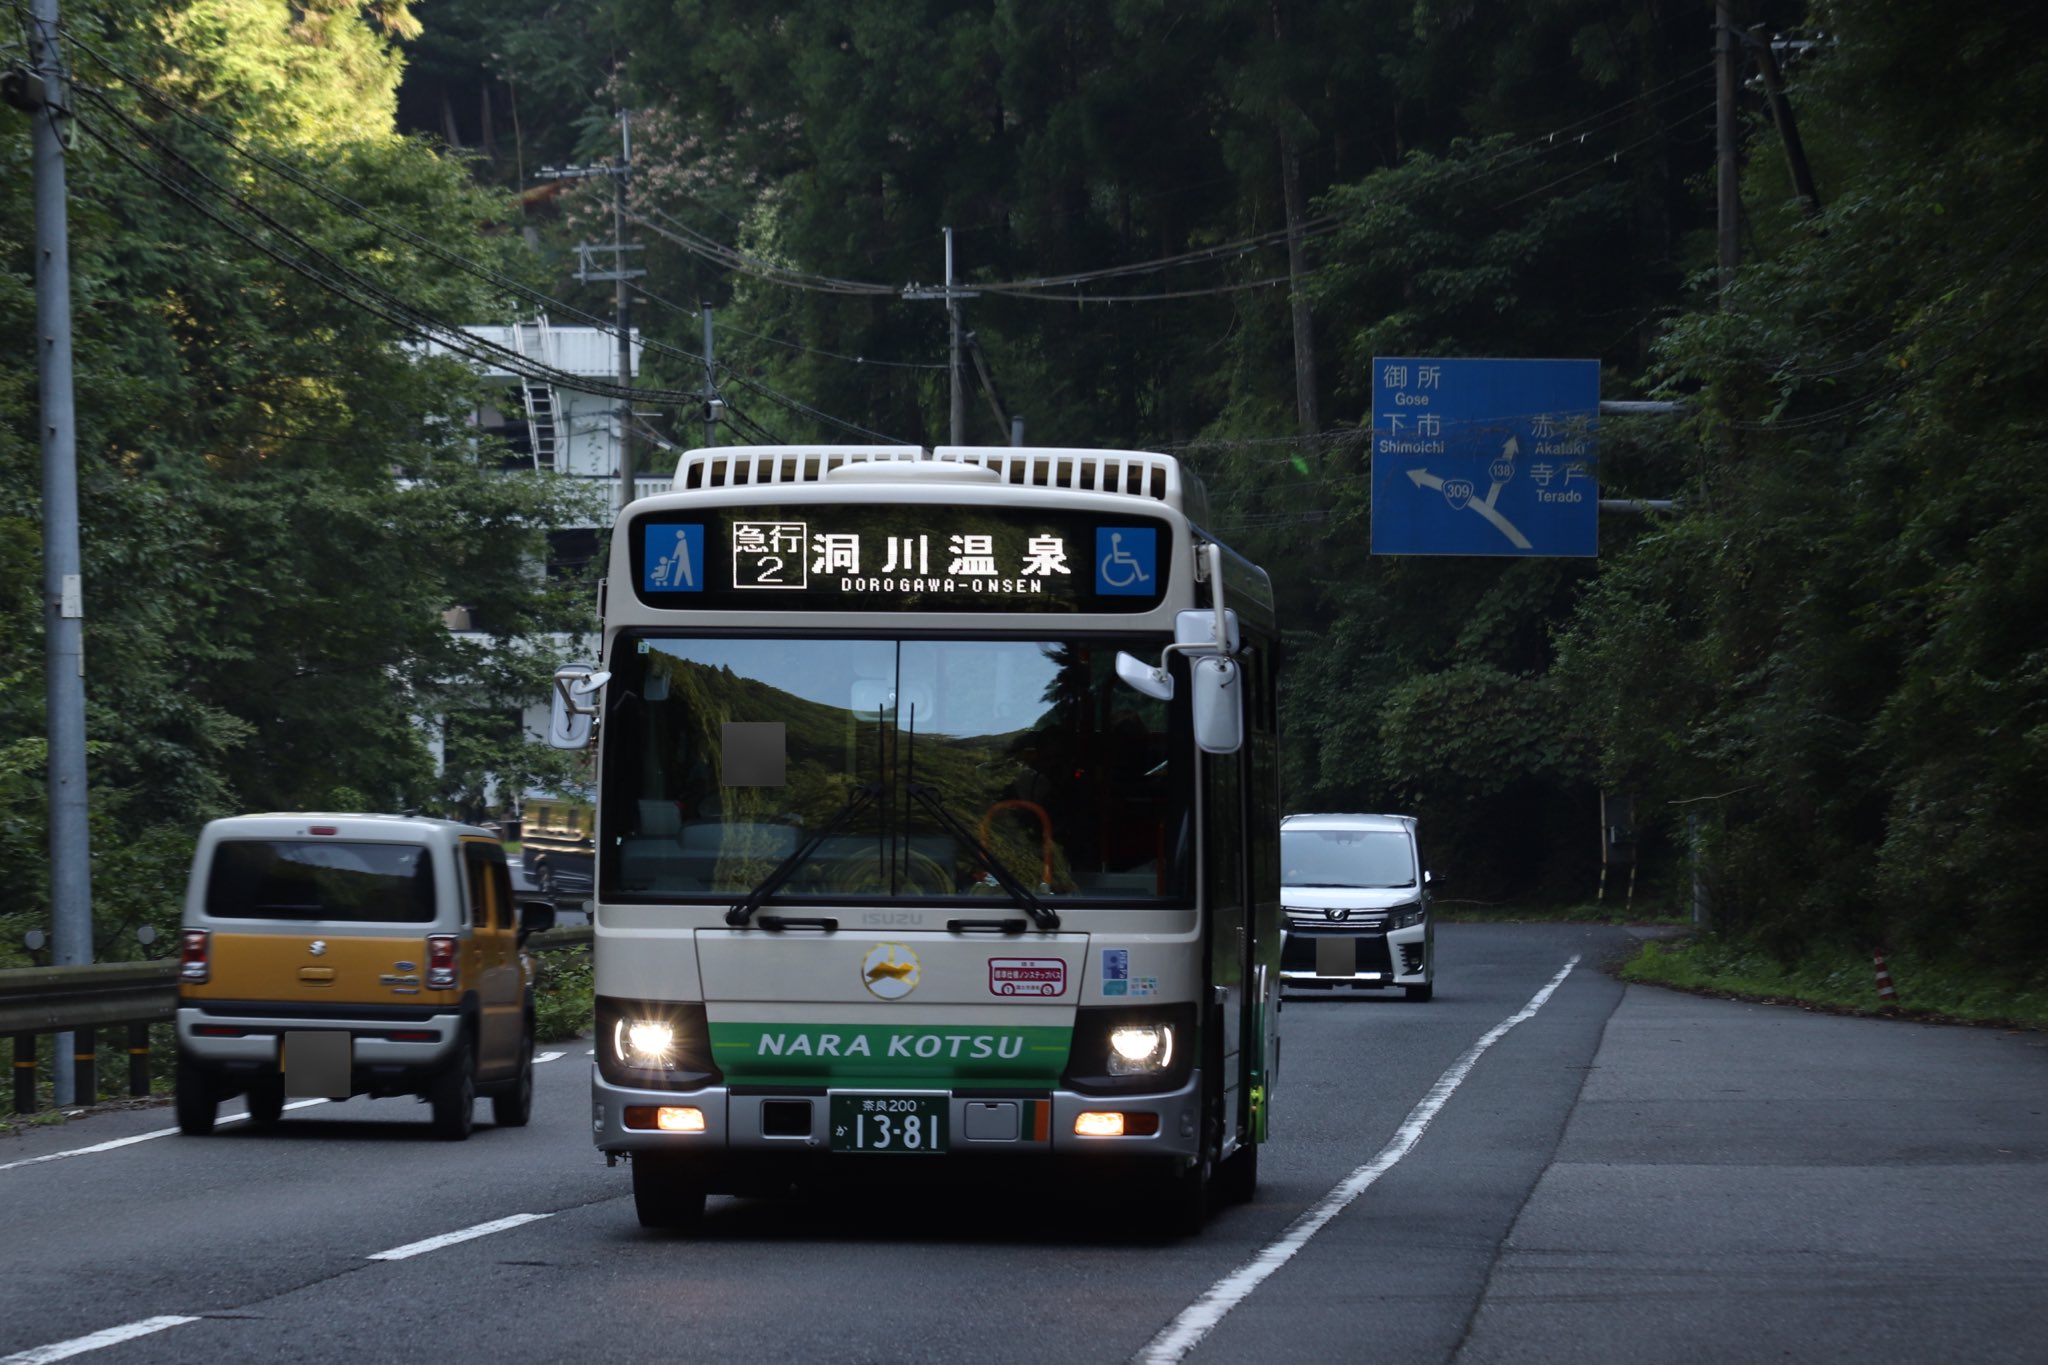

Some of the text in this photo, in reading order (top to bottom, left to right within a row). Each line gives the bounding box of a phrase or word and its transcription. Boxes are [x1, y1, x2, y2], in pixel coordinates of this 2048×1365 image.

[1383, 365, 1441, 390] 御所
[1395, 392, 1429, 406] Gose
[1383, 412, 1440, 437] 下市
[1379, 440, 1444, 454] Shimoichi
[1492, 464, 1511, 478] 138
[1447, 483, 1470, 499] 309
[1535, 489, 1582, 503] Terado
[735, 525, 802, 554] 急行
[811, 533, 1071, 577] 洞川温泉
[757, 556, 784, 583] 2
[841, 578, 1042, 594] DOROGAWA-ONSEN
[863, 912, 922, 925] ISUZU
[758, 1034, 1024, 1058] NARA KOTSU
[856, 1114, 938, 1149] 13-81
